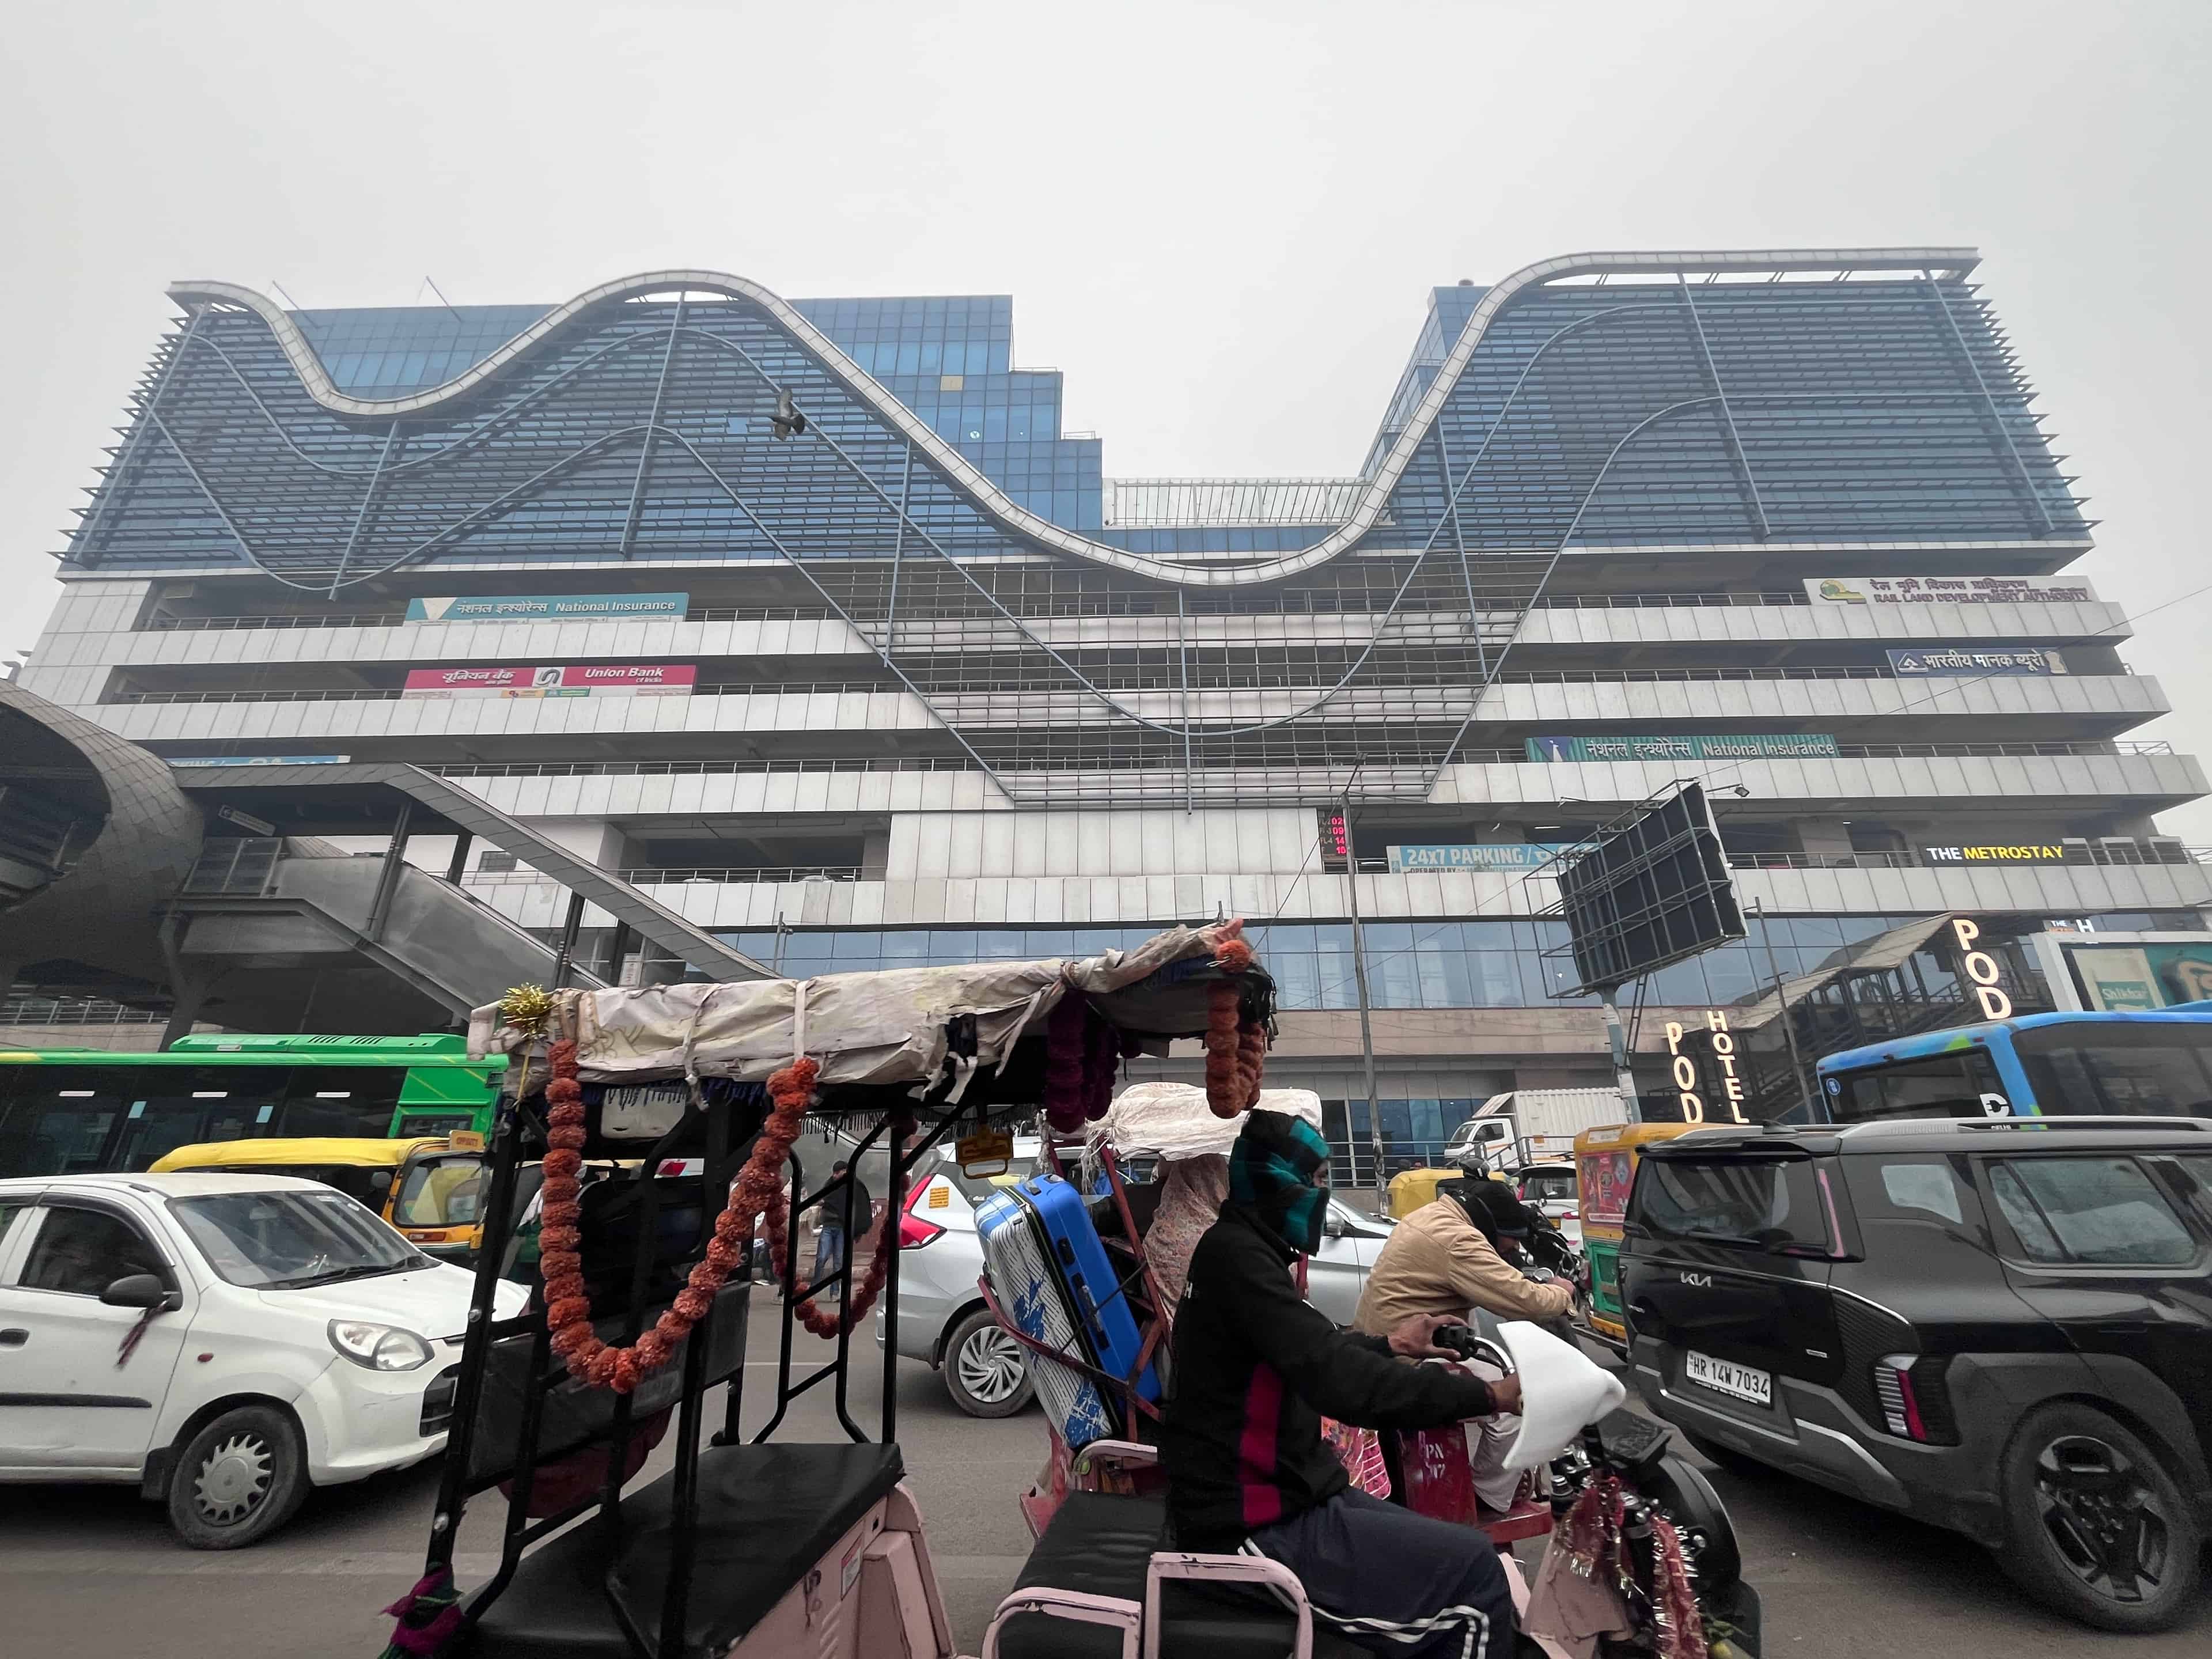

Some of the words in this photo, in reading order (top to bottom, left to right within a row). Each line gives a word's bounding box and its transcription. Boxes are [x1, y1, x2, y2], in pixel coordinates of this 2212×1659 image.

[1873, 593, 1902, 603] RAIL
[1902, 593, 1934, 602] LAND
[1936, 590, 2020, 602] DEVELOPMENT
[2024, 589, 2088, 600] AUTHORITY
[555, 601, 608, 612] National
[612, 600, 676, 611] Insurance
[1923, 649, 1974, 668] भारतीय
[1972, 654, 2014, 668] मानक
[585, 668, 627, 678] Union
[627, 667, 664, 677] Bank
[1702, 741, 1762, 756] National
[1764, 740, 1835, 755] Insurance
[1407, 848, 1445, 865] 24x7
[1449, 847, 1524, 865] PARKING
[1926, 847, 1962, 860] THE
[1963, 845, 2063, 860] METROSTAY
[1952, 918, 2012, 1020] POD
[1665, 1021, 1703, 1123] POD
[1707, 1010, 1750, 1123] HOTEL
[1694, 1356, 1706, 1377] HR
[1736, 1369, 1768, 1397] 7034
